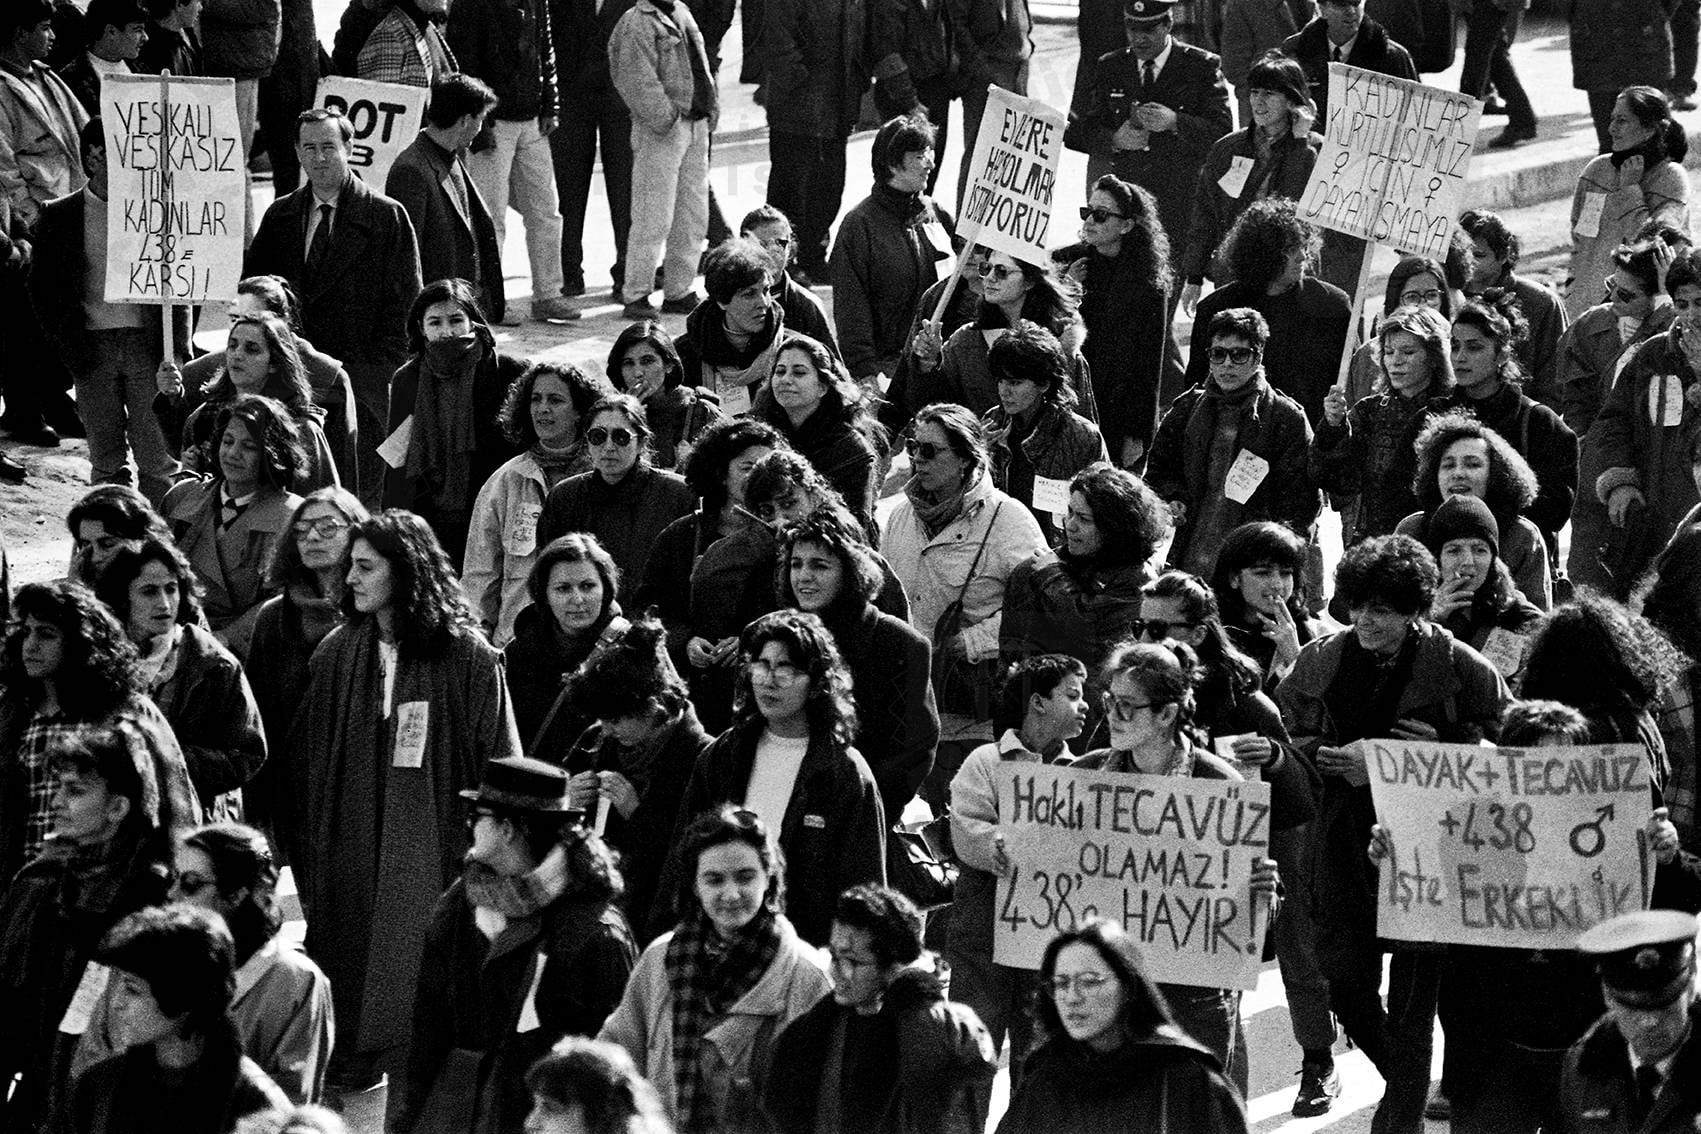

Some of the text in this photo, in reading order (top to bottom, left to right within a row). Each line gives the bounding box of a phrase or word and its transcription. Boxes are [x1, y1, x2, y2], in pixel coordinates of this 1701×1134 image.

[1345, 68, 1470, 138] KADINLAR
[124, 198, 228, 236] KADINLAR
[1012, 774, 1269, 847] Haklı TECAVÜZ
[1079, 840, 1230, 890] OLAMAZ!
[1123, 888, 1258, 956] HAYIR!
